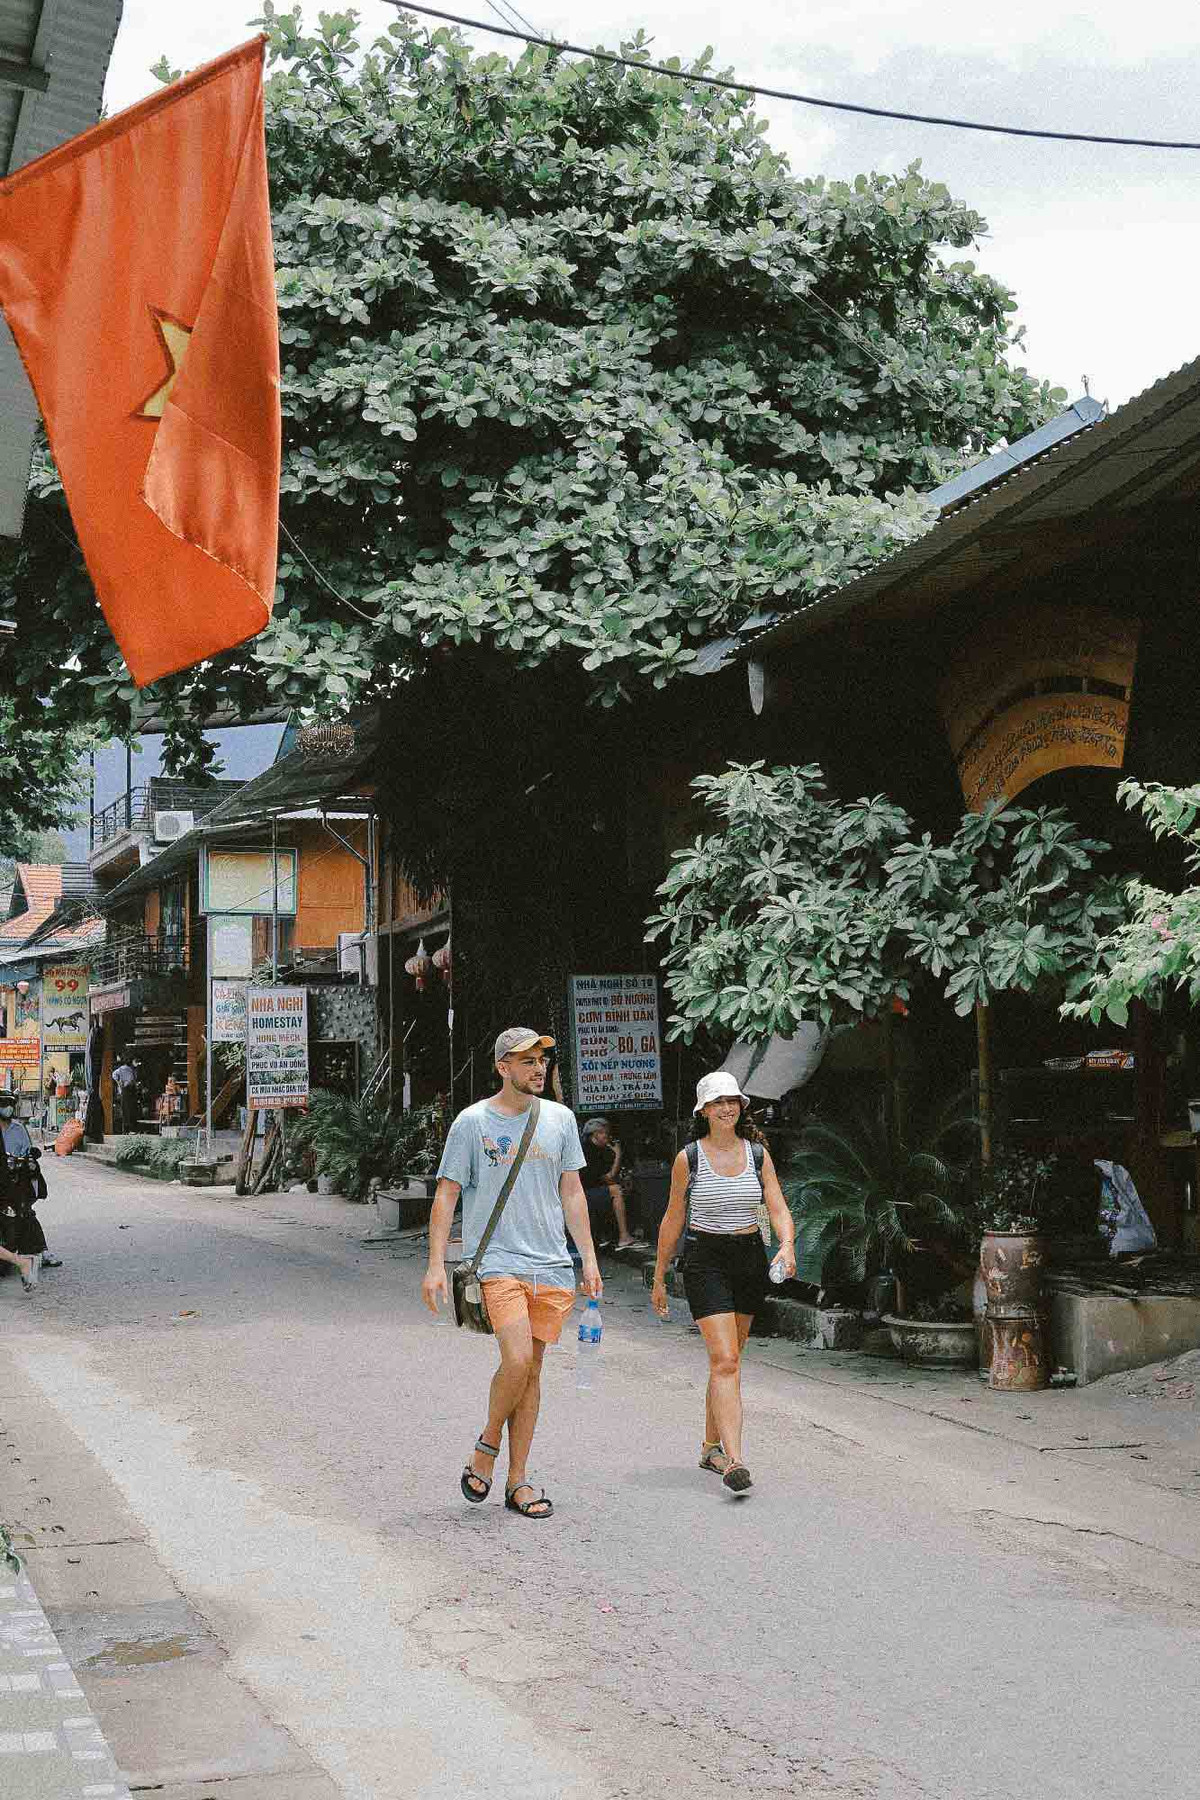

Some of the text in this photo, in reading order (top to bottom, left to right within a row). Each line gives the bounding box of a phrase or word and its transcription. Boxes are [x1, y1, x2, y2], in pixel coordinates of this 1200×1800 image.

[54, 978, 79, 993] 99
[576, 978, 597, 989] NHÀ
[252, 1016, 303, 1029] HOMESTAY
[578, 1011, 602, 1023] CƠM
[580, 1035, 608, 1046] BÚN
[641, 1031, 657, 1054] GÀ
[581, 1045, 608, 1058] PHỞ
[600, 1058, 619, 1071] NẾP
